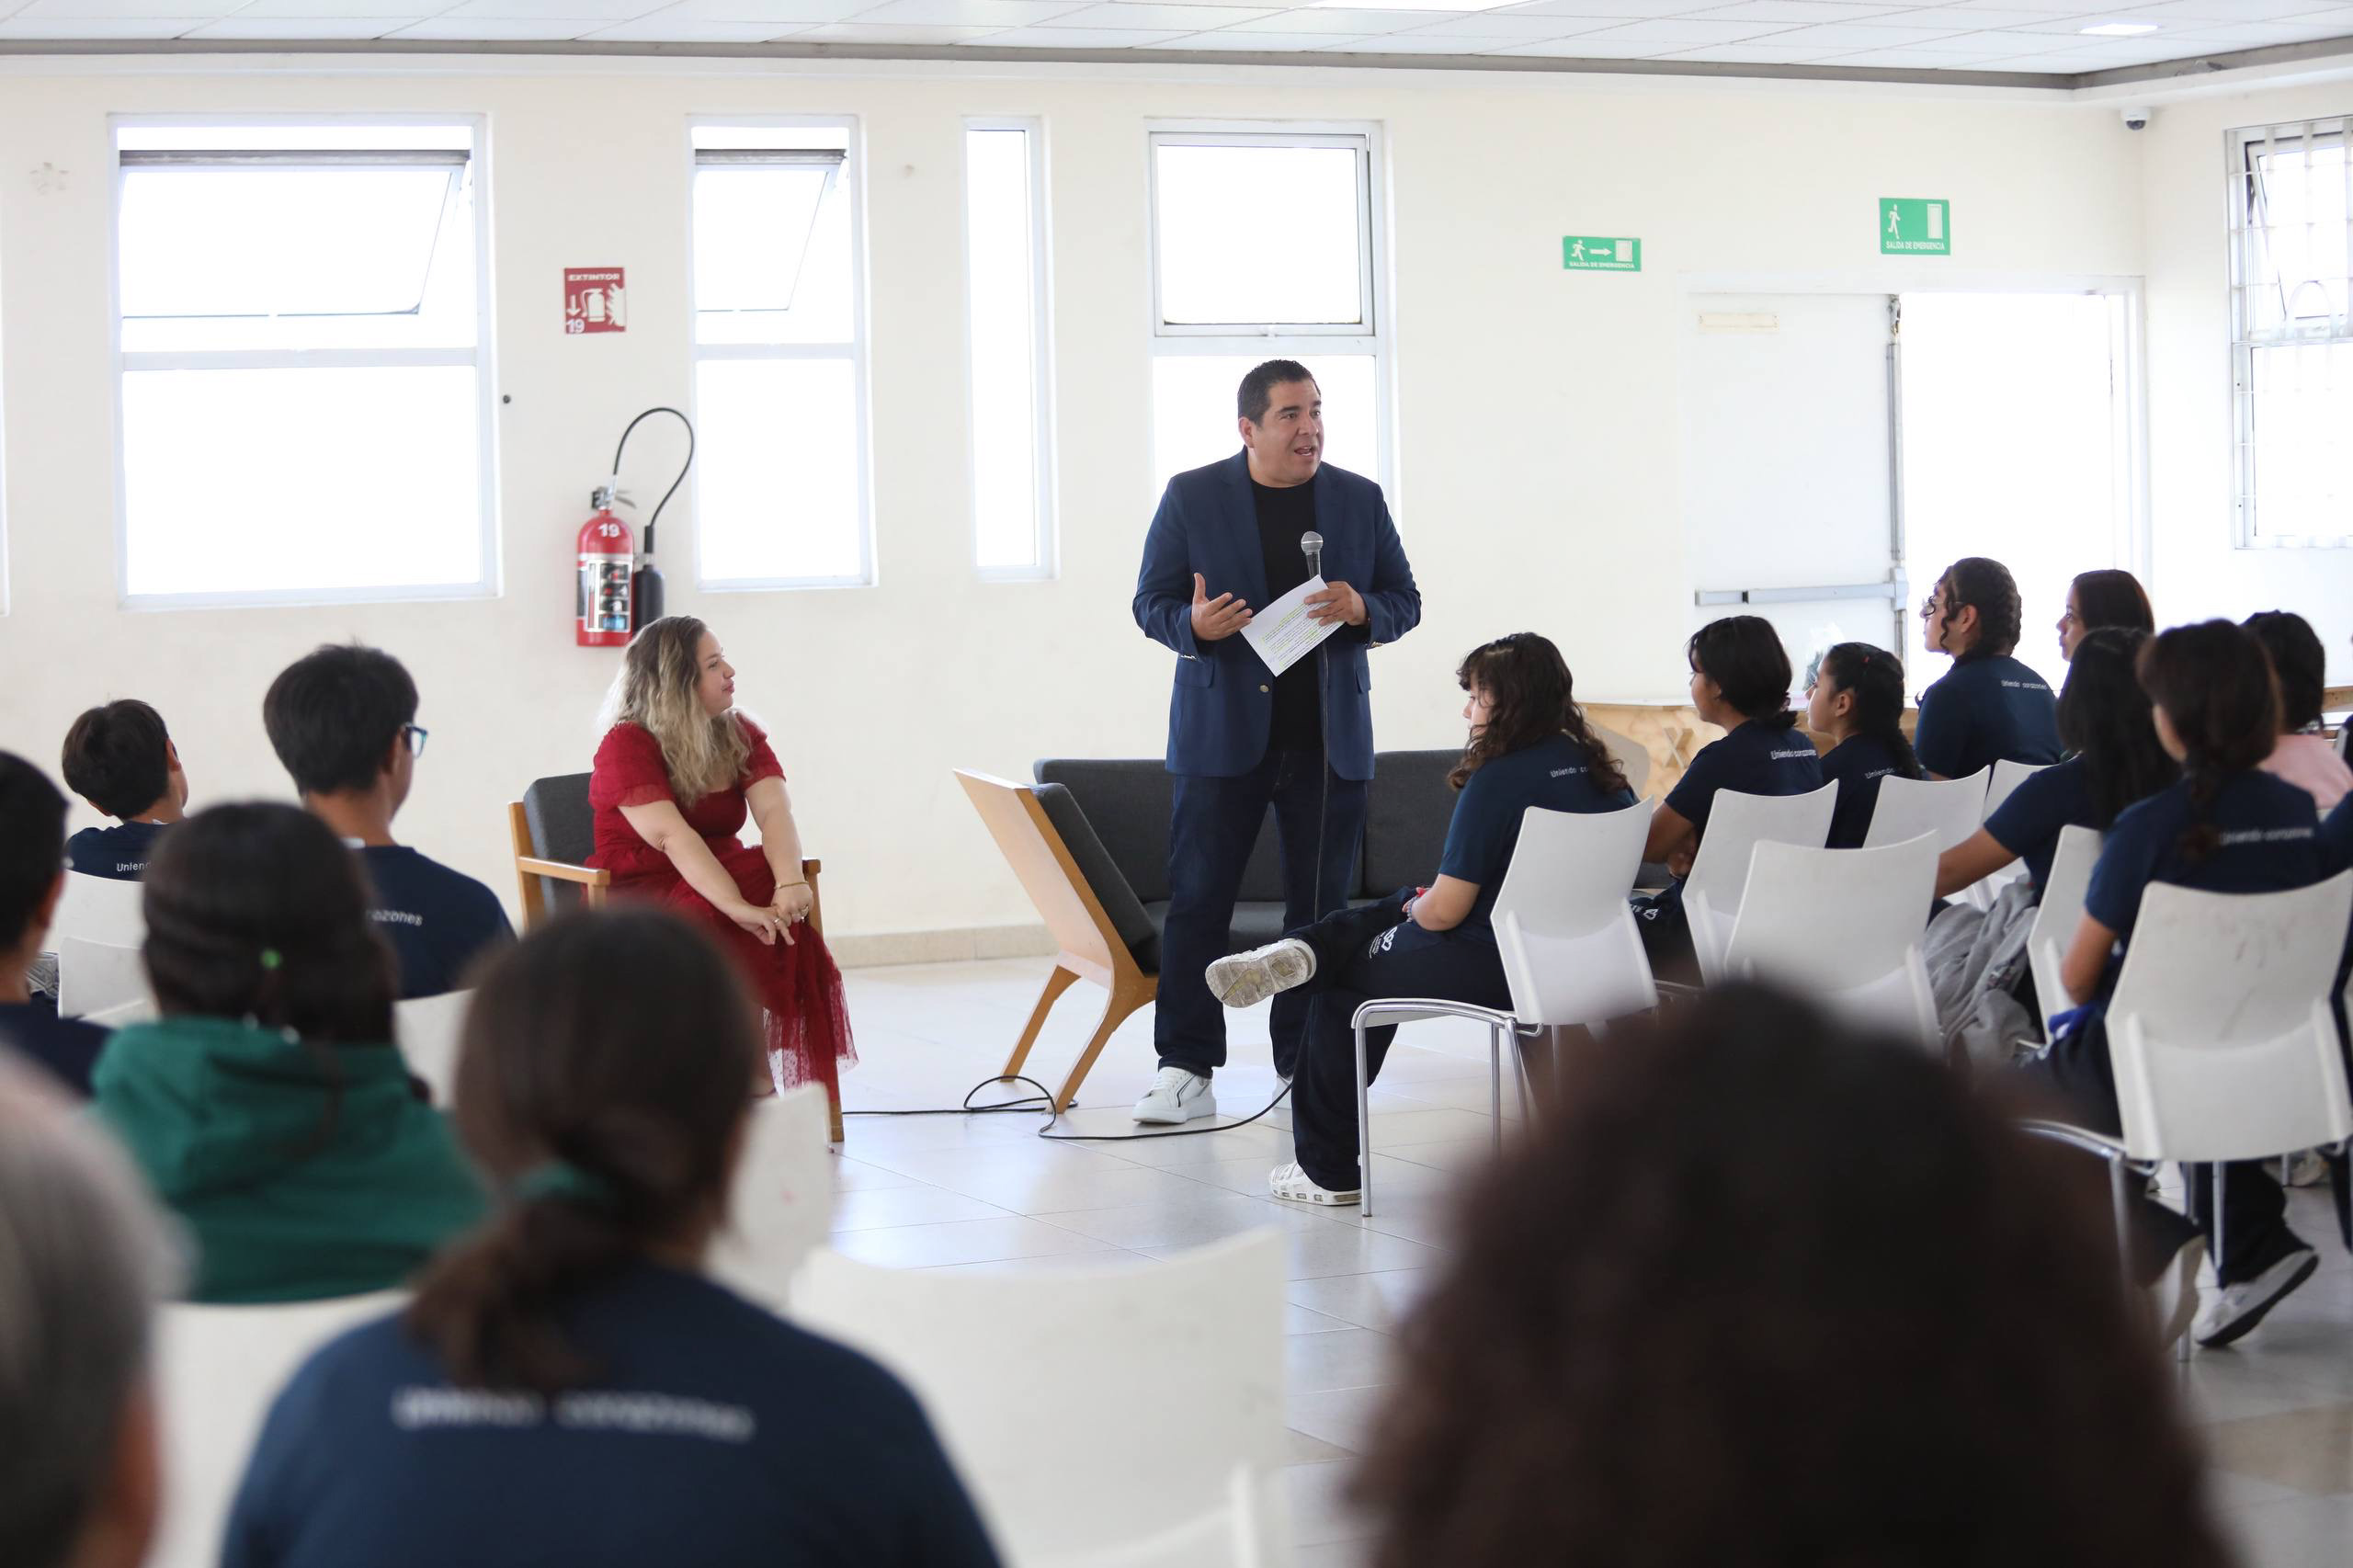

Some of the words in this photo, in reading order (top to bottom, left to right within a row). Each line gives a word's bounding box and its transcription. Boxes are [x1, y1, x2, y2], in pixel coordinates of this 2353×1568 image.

[568, 273, 620, 281] EXTINTOR
[566, 318, 585, 333] 19
[598, 523, 620, 538] 19
[117, 861, 153, 872] Uniend
